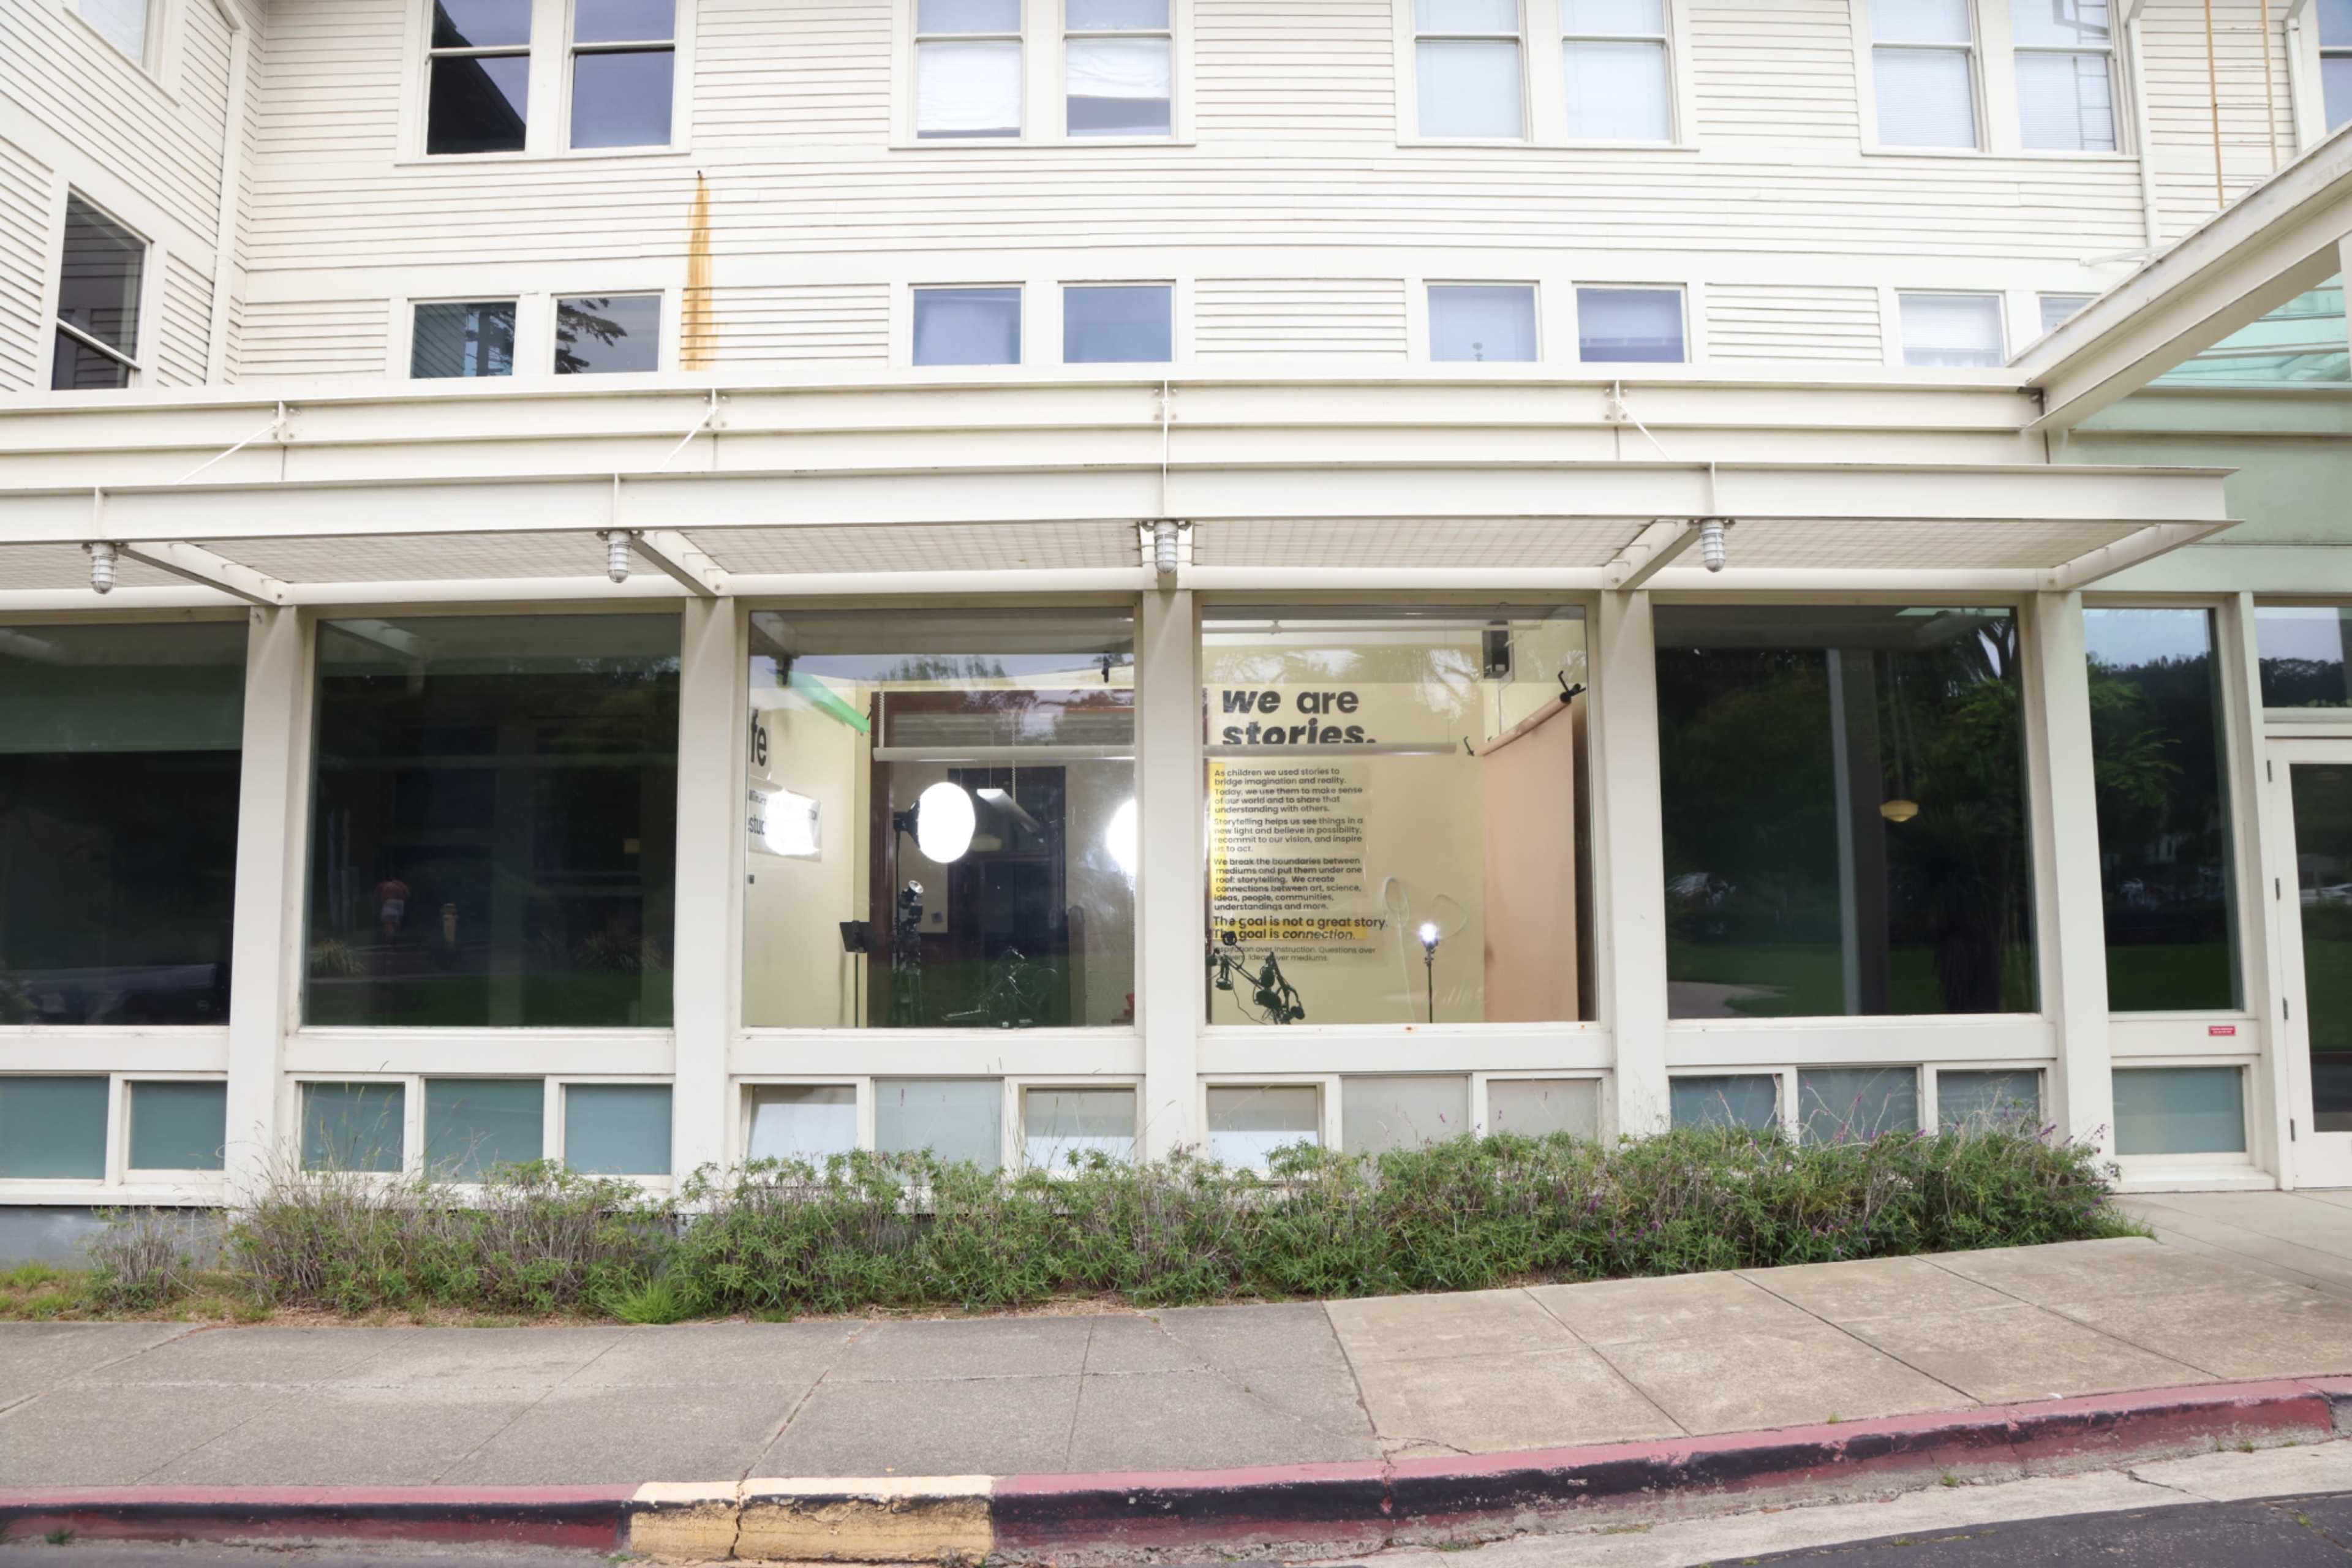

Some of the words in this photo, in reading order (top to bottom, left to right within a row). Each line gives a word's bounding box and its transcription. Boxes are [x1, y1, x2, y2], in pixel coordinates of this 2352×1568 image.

[1223, 690, 1281, 714] we
[1297, 690, 1359, 714] are
[1223, 718, 1376, 745] stories.
[1215, 778, 1242, 786] bridge
[1245, 777, 1296, 786] imagination
[1317, 777, 1346, 785] reality.
[1215, 805, 1278, 814] understanding
[1215, 818, 1262, 827] Storytelling
[1319, 817, 1345, 826] things
[1333, 835, 1362, 844] inspire
[1213, 916, 1235, 926] The
[1239, 916, 1265, 929] goal
[1270, 916, 1279, 926] is
[1283, 917, 1303, 926] not
[1317, 918, 1351, 930] great
[1354, 918, 1388, 930] story.
[1239, 929, 1265, 941] goal
[1270, 929, 1279, 938] is
[1283, 929, 1355, 940] connection.
